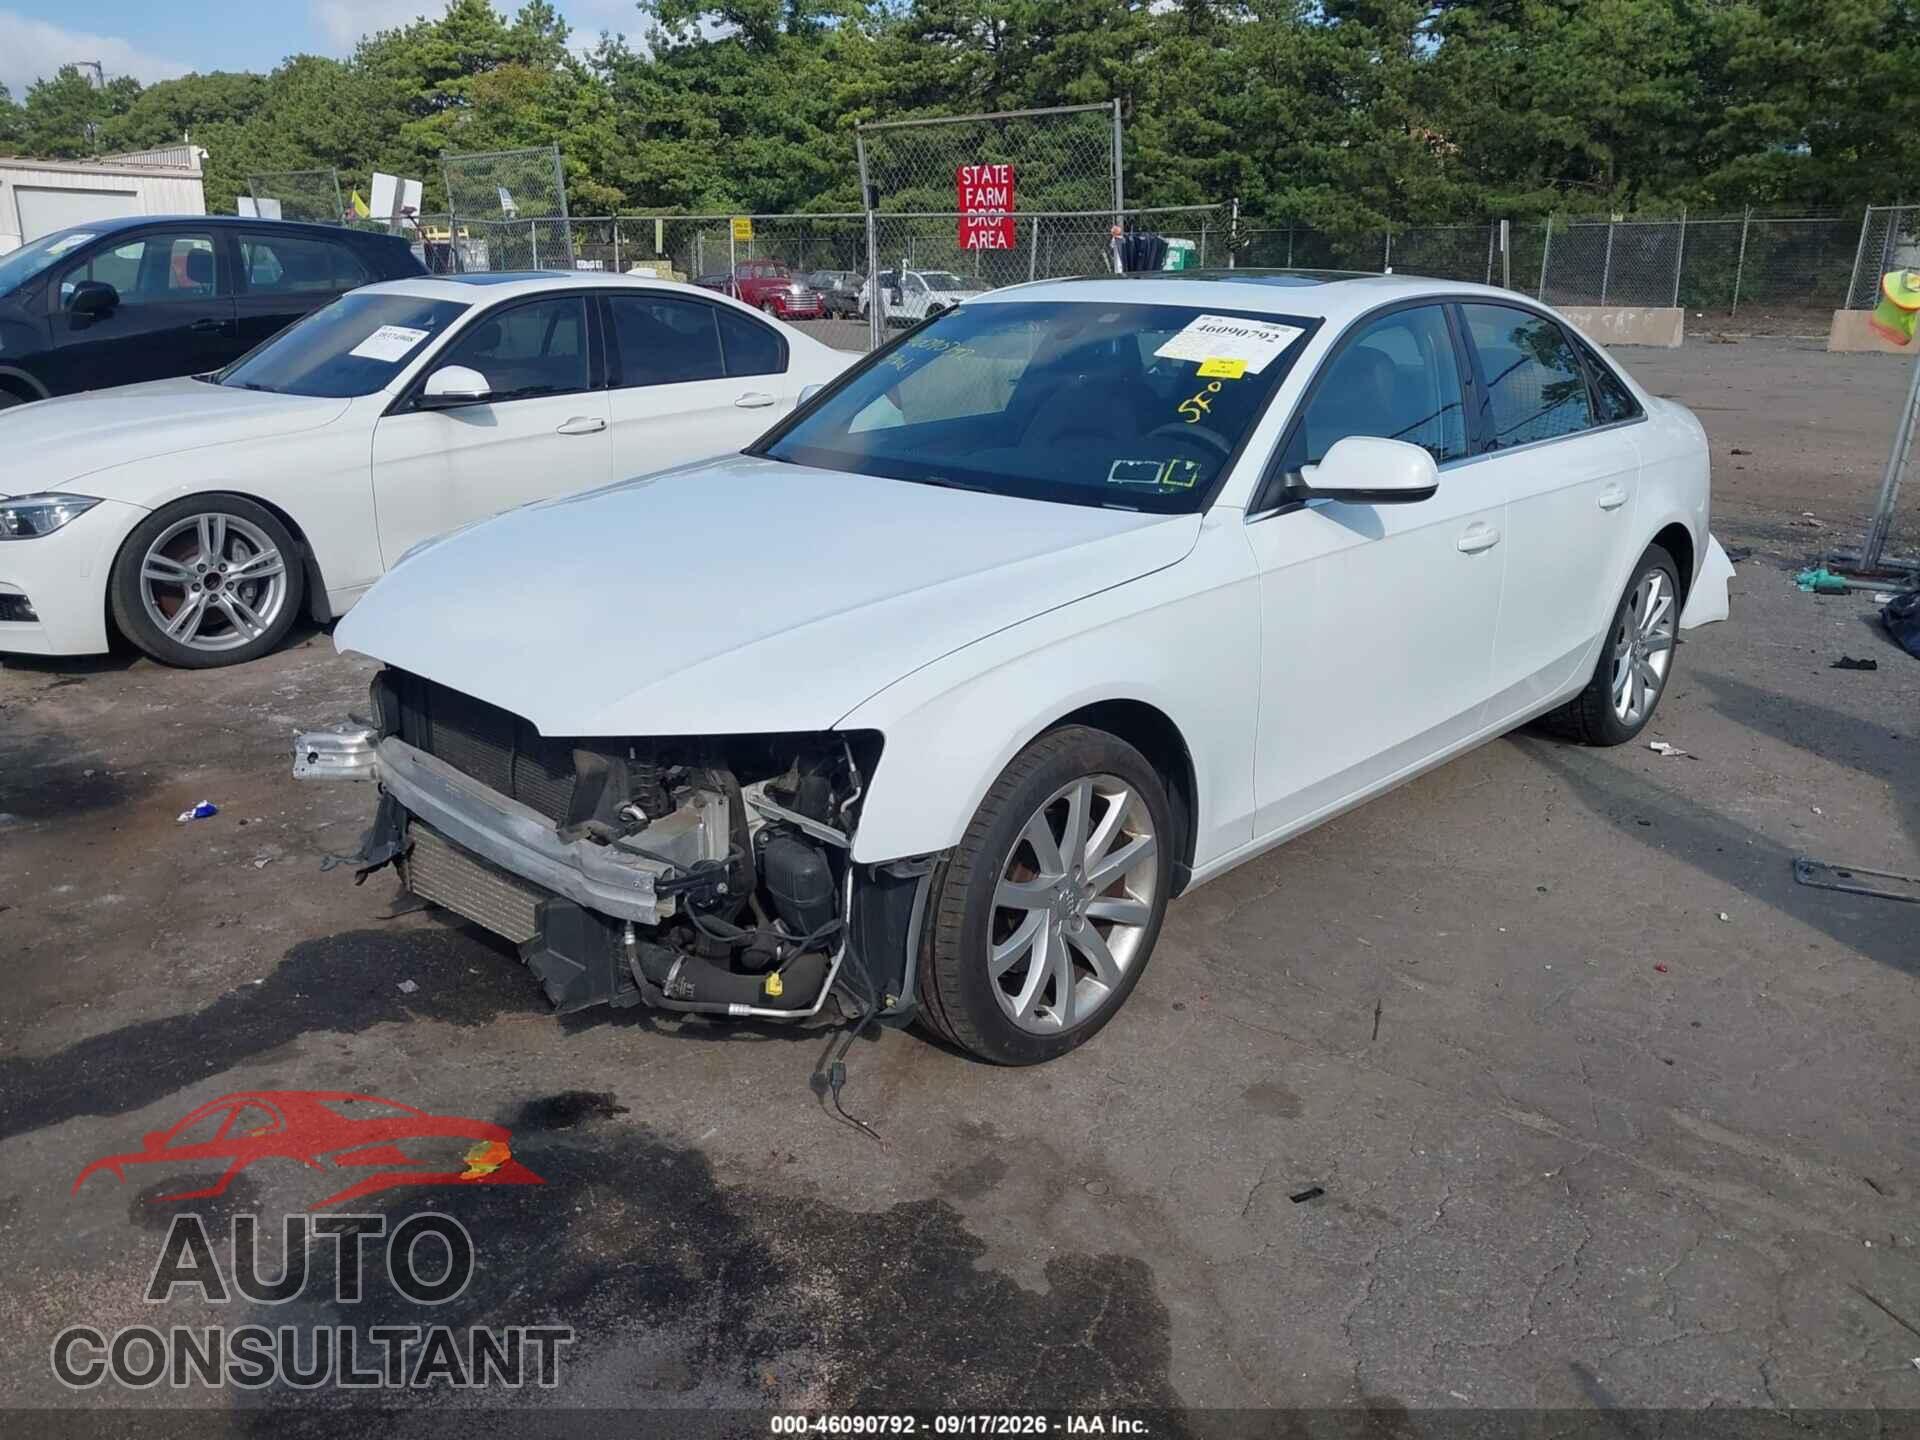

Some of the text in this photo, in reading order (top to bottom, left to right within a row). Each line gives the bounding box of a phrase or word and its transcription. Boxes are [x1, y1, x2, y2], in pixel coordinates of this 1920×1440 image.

[962, 165, 1009, 185] STATE
[965, 187, 1007, 207] FARM
[967, 208, 1006, 227] DROP
[967, 230, 1008, 249] AREA
[1196, 323, 1280, 343] 46090792
